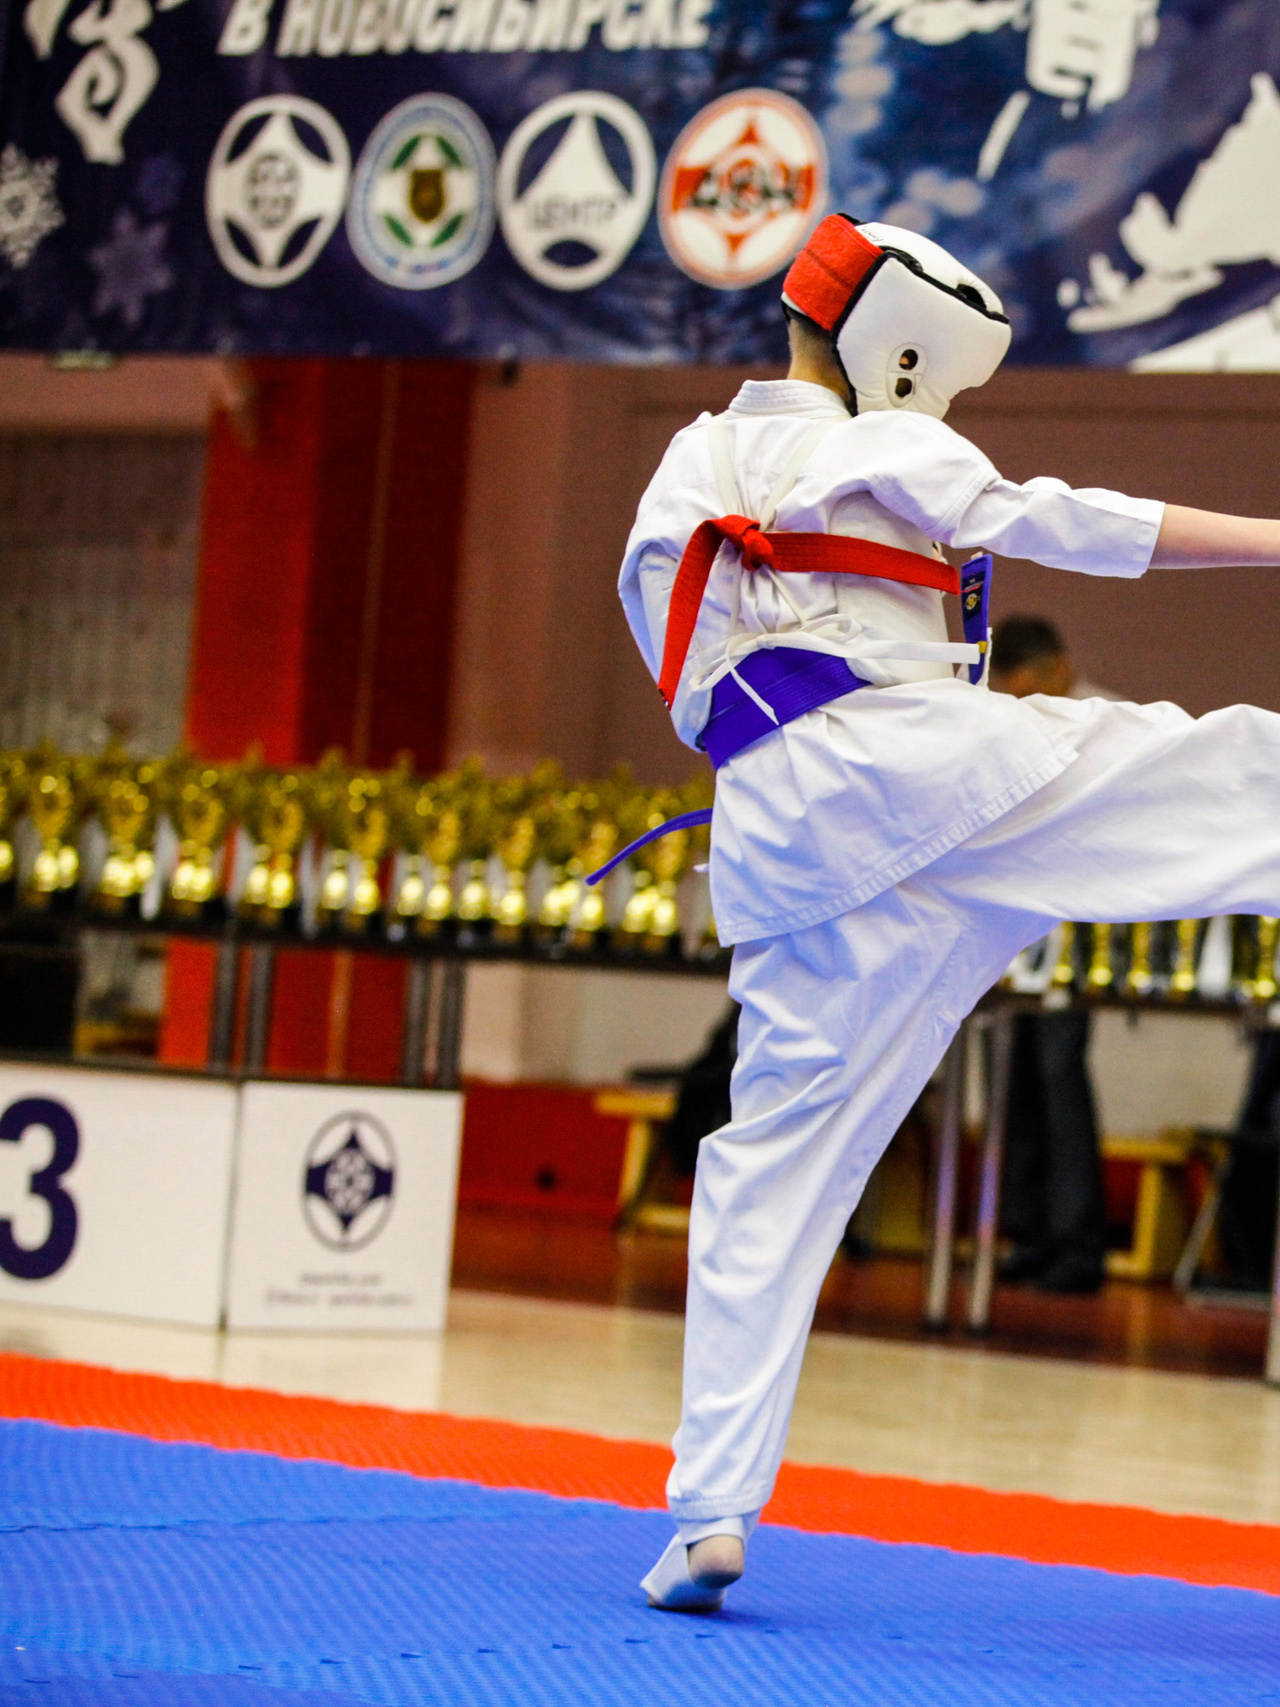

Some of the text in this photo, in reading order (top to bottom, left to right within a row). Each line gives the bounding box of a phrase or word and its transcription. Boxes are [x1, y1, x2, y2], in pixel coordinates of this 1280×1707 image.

[216, 0, 716, 58] В НОВОСИБИРСКЕ
[526, 193, 618, 230] ЦЕНТР
[0, 1096, 80, 1281] 3
